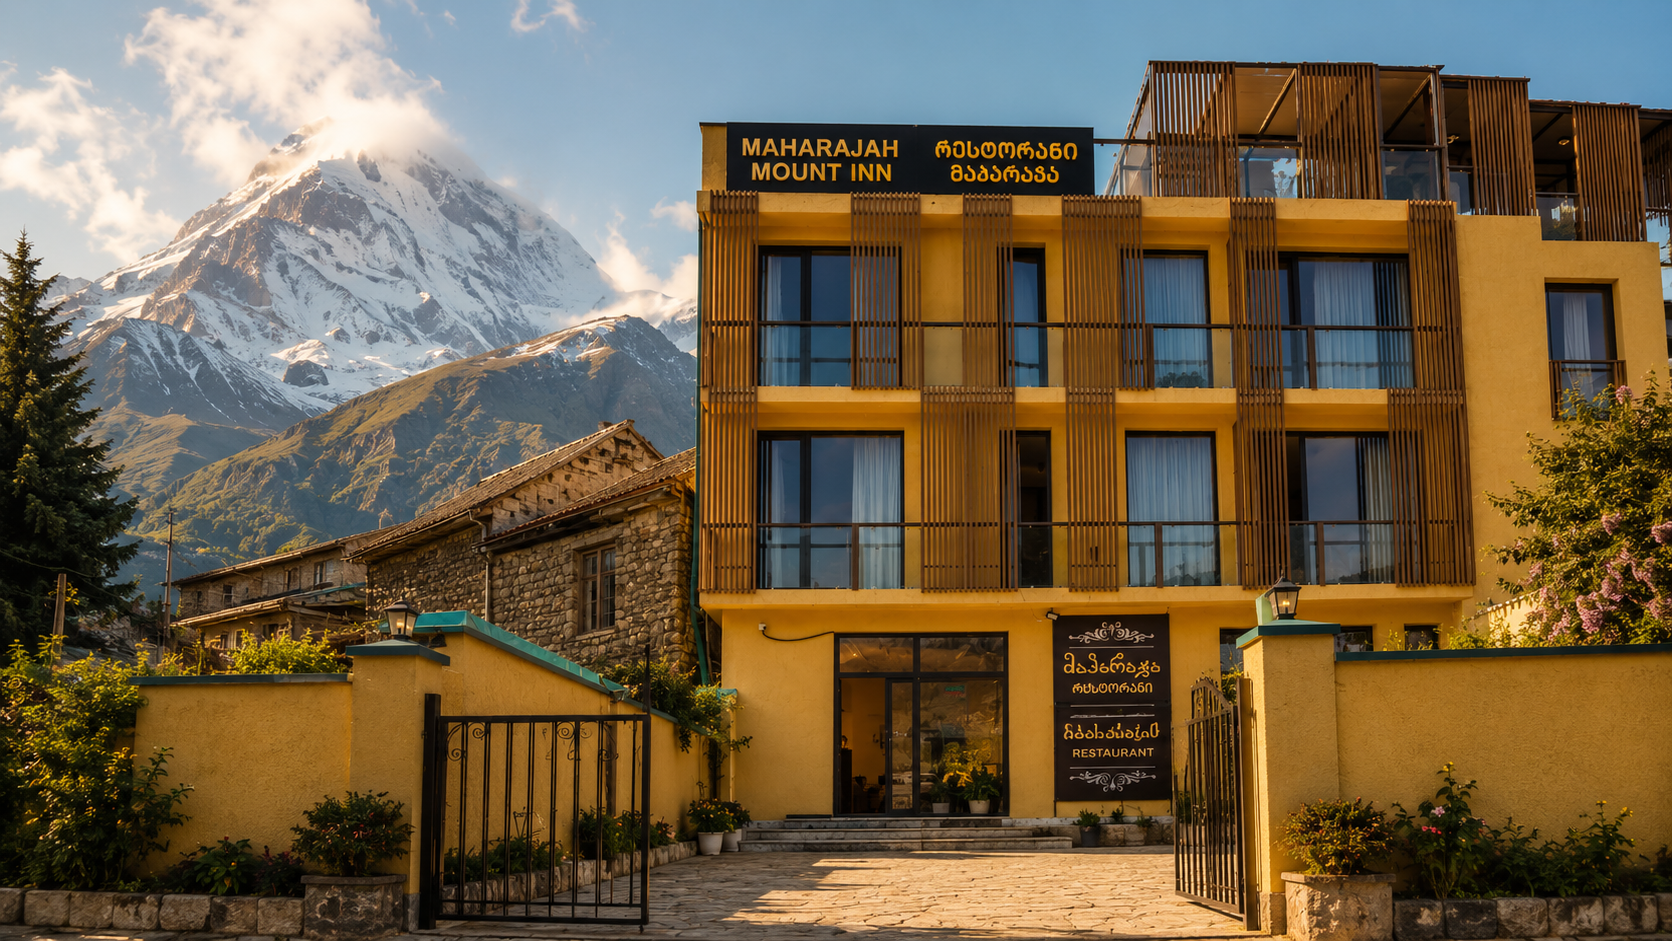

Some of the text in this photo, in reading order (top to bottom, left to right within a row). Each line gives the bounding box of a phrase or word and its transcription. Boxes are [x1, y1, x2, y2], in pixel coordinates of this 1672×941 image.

[741, 137, 899, 158] MAHARAJAH
[934, 139, 1078, 161] რესტორანი
[751, 162, 892, 182] MOUNT INN
[1072, 747, 1155, 758] RESTAURANT
